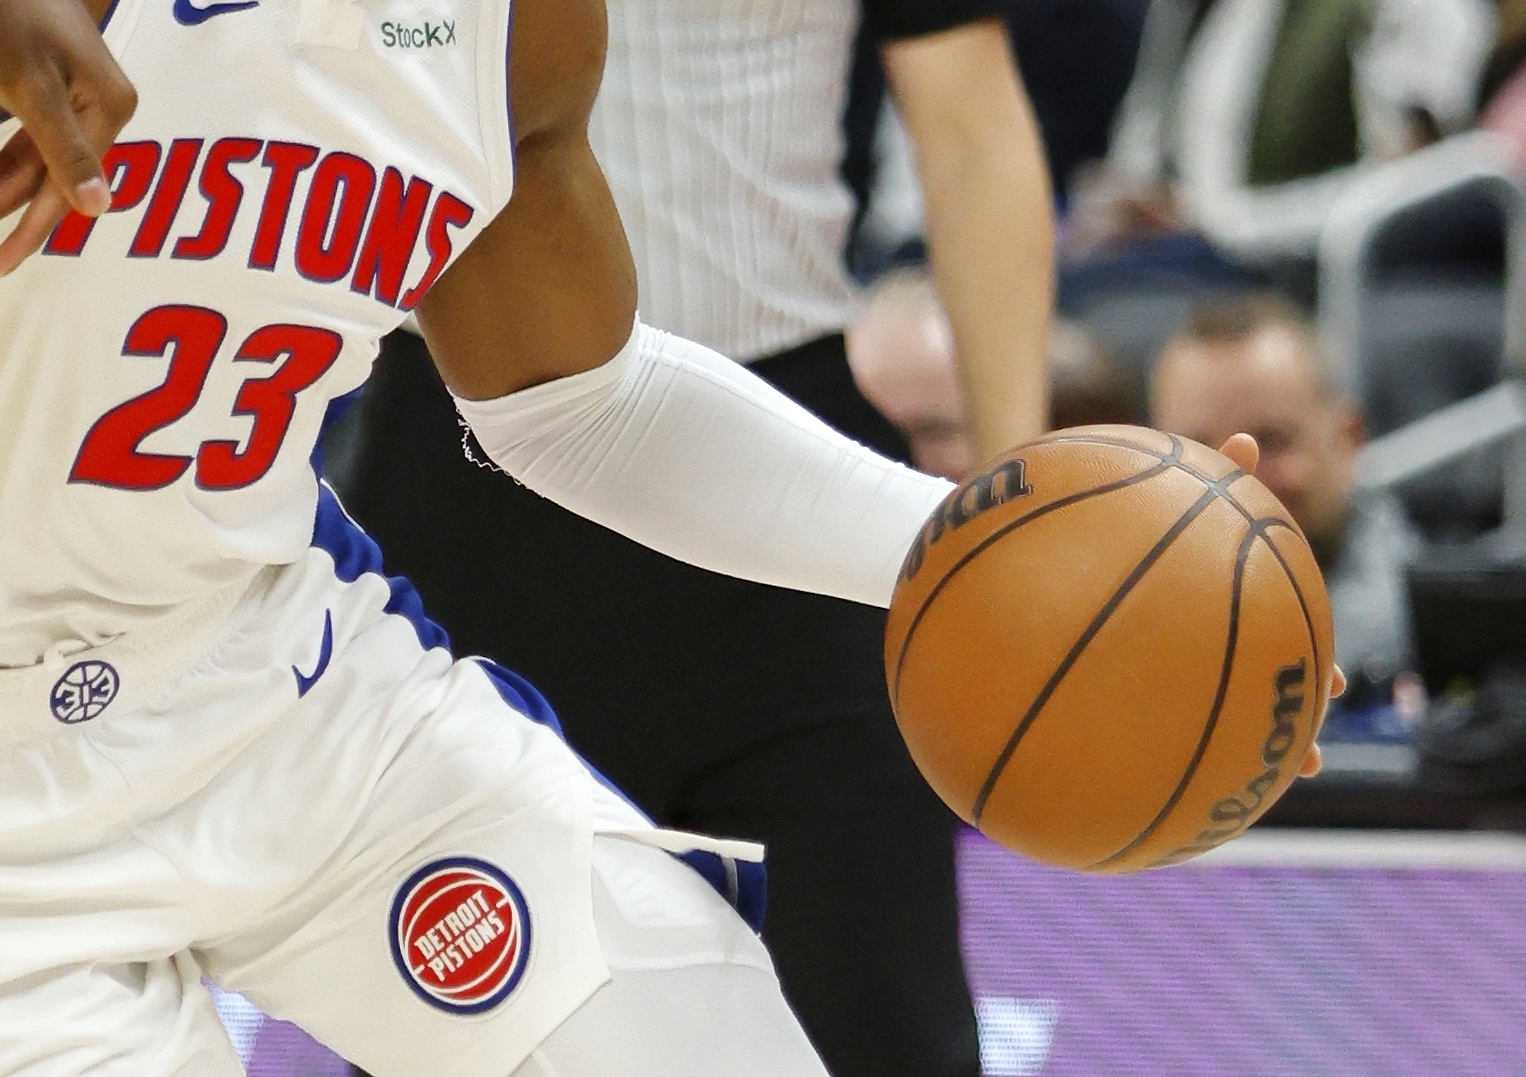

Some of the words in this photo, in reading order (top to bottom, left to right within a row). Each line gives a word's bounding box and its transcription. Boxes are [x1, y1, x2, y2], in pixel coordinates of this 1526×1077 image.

[381, 19, 456, 48] StockX
[42, 137, 474, 312] PISTONS
[67, 304, 343, 491] 23
[414, 890, 490, 960] DETROIT
[427, 910, 506, 982] PISTONS
